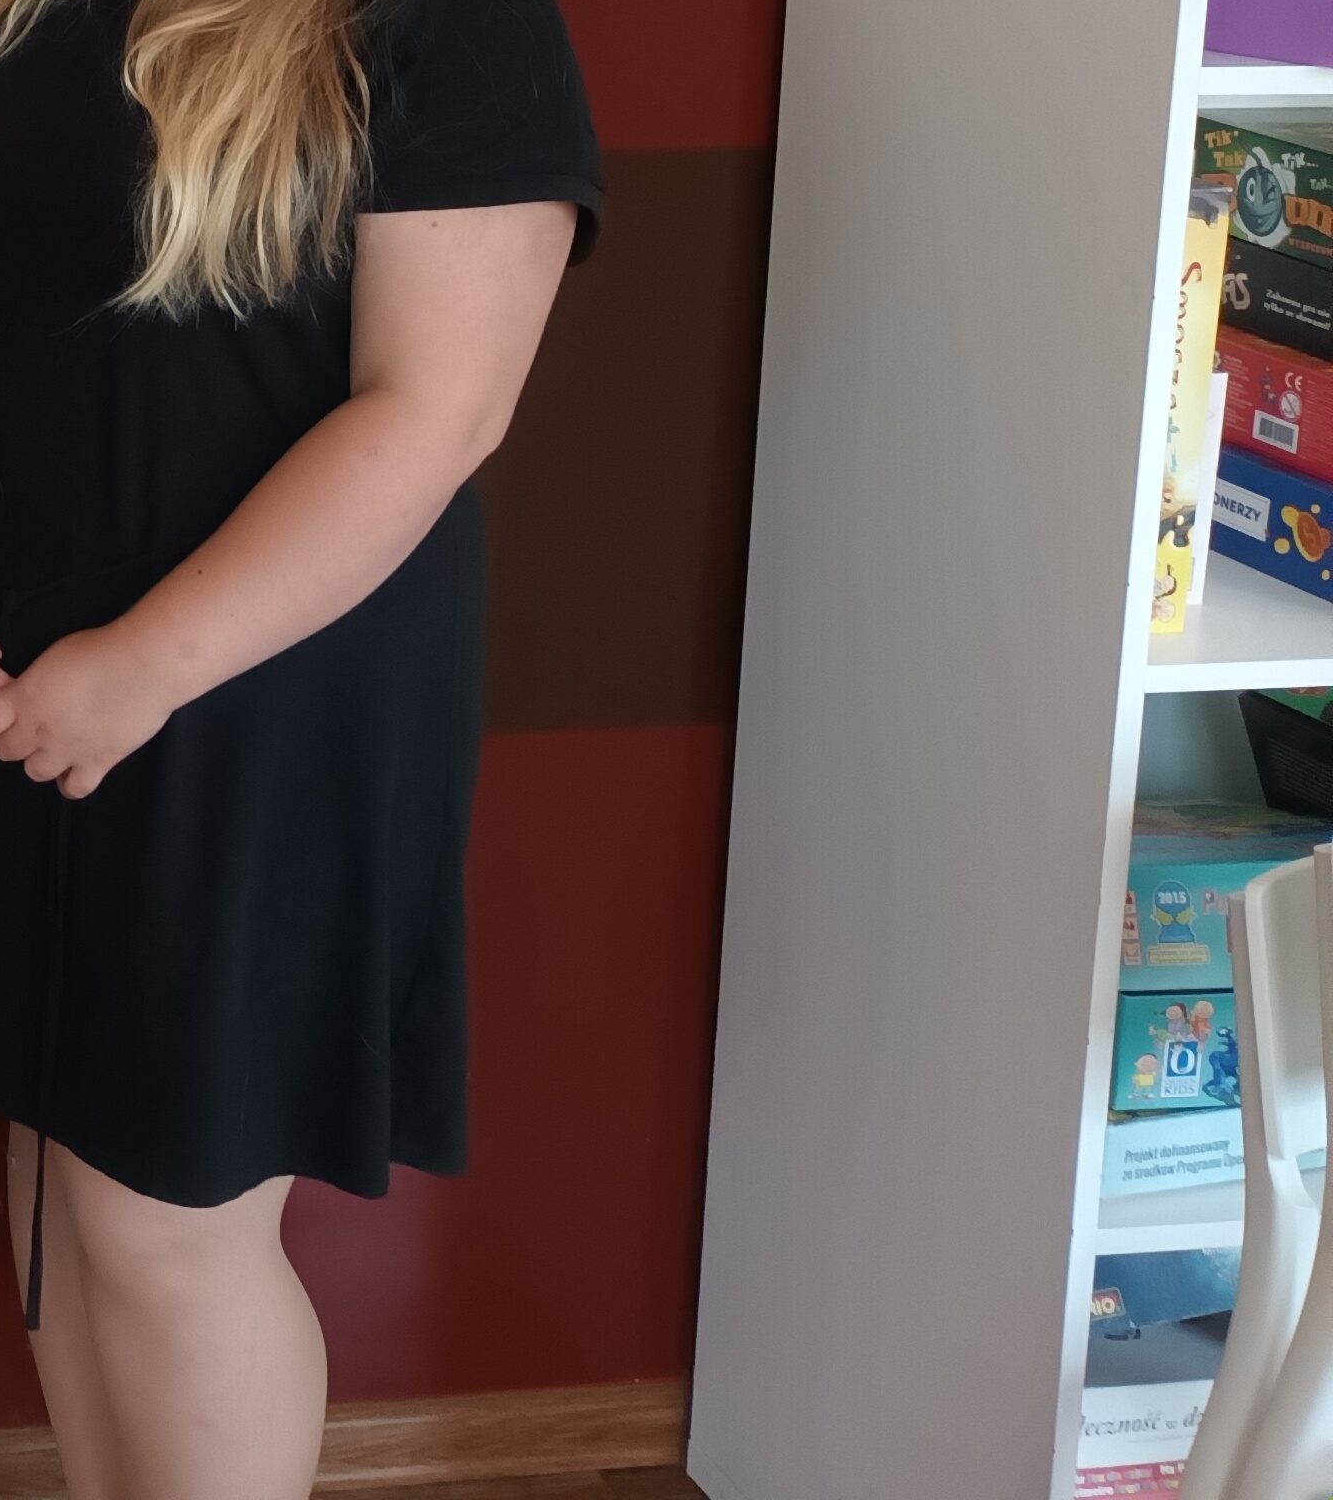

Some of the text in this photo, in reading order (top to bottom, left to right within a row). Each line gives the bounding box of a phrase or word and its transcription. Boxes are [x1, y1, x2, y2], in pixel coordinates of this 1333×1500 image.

[1157, 890, 1187, 905] 2015
[1164, 1085, 1197, 1096] KIDS
[1124, 1148, 1158, 1164] Projekt
